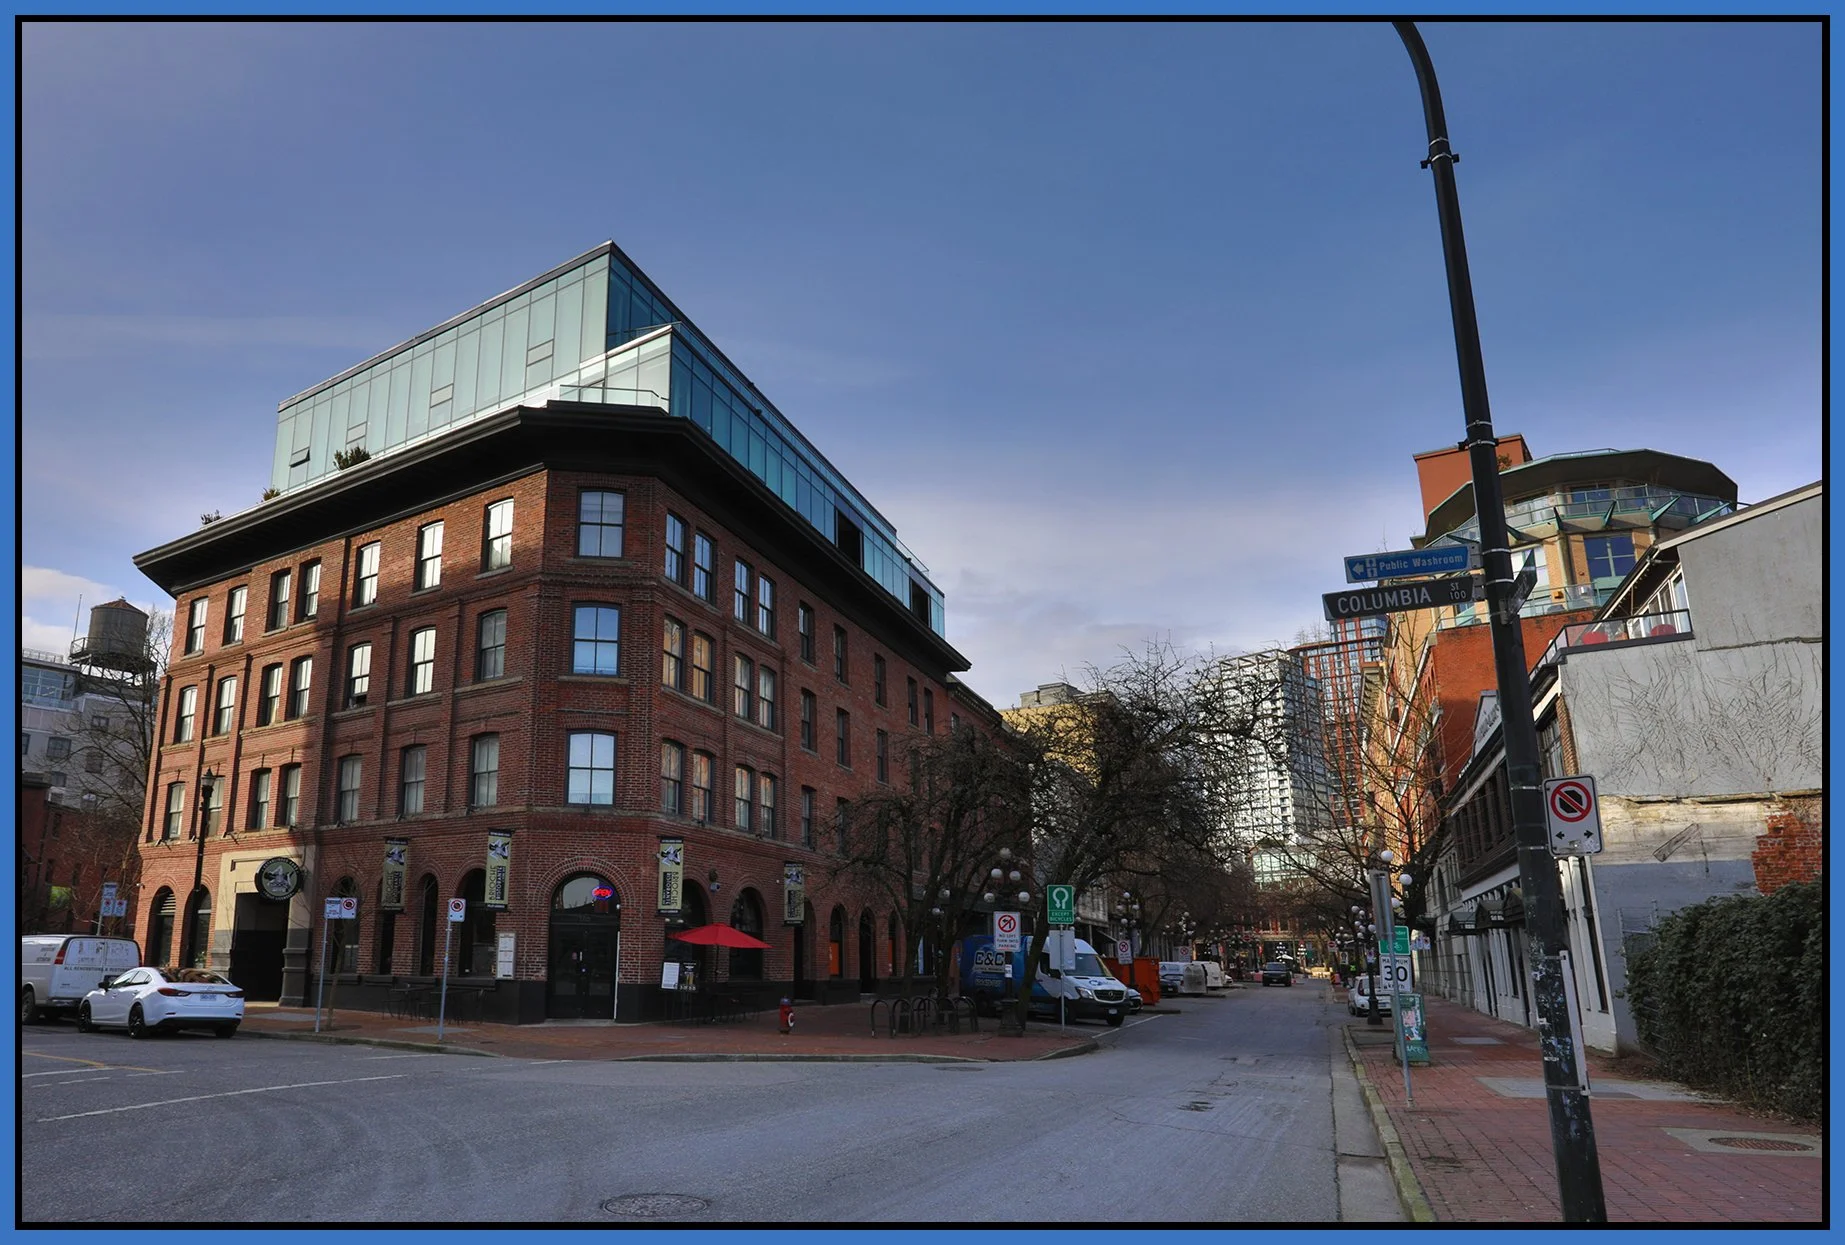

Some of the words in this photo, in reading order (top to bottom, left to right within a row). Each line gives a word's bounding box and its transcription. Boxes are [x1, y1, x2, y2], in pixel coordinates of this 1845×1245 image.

[1379, 560, 1408, 571] Public
[1412, 555, 1463, 567] Washroom
[1450, 582, 1459, 591] ST
[1337, 587, 1432, 614] COLUMBIA
[1450, 590, 1466, 600] 100
[488, 864, 496, 901] BRIOCHE
[975, 952, 1004, 966] C&C
[1384, 965, 1408, 982] 30
